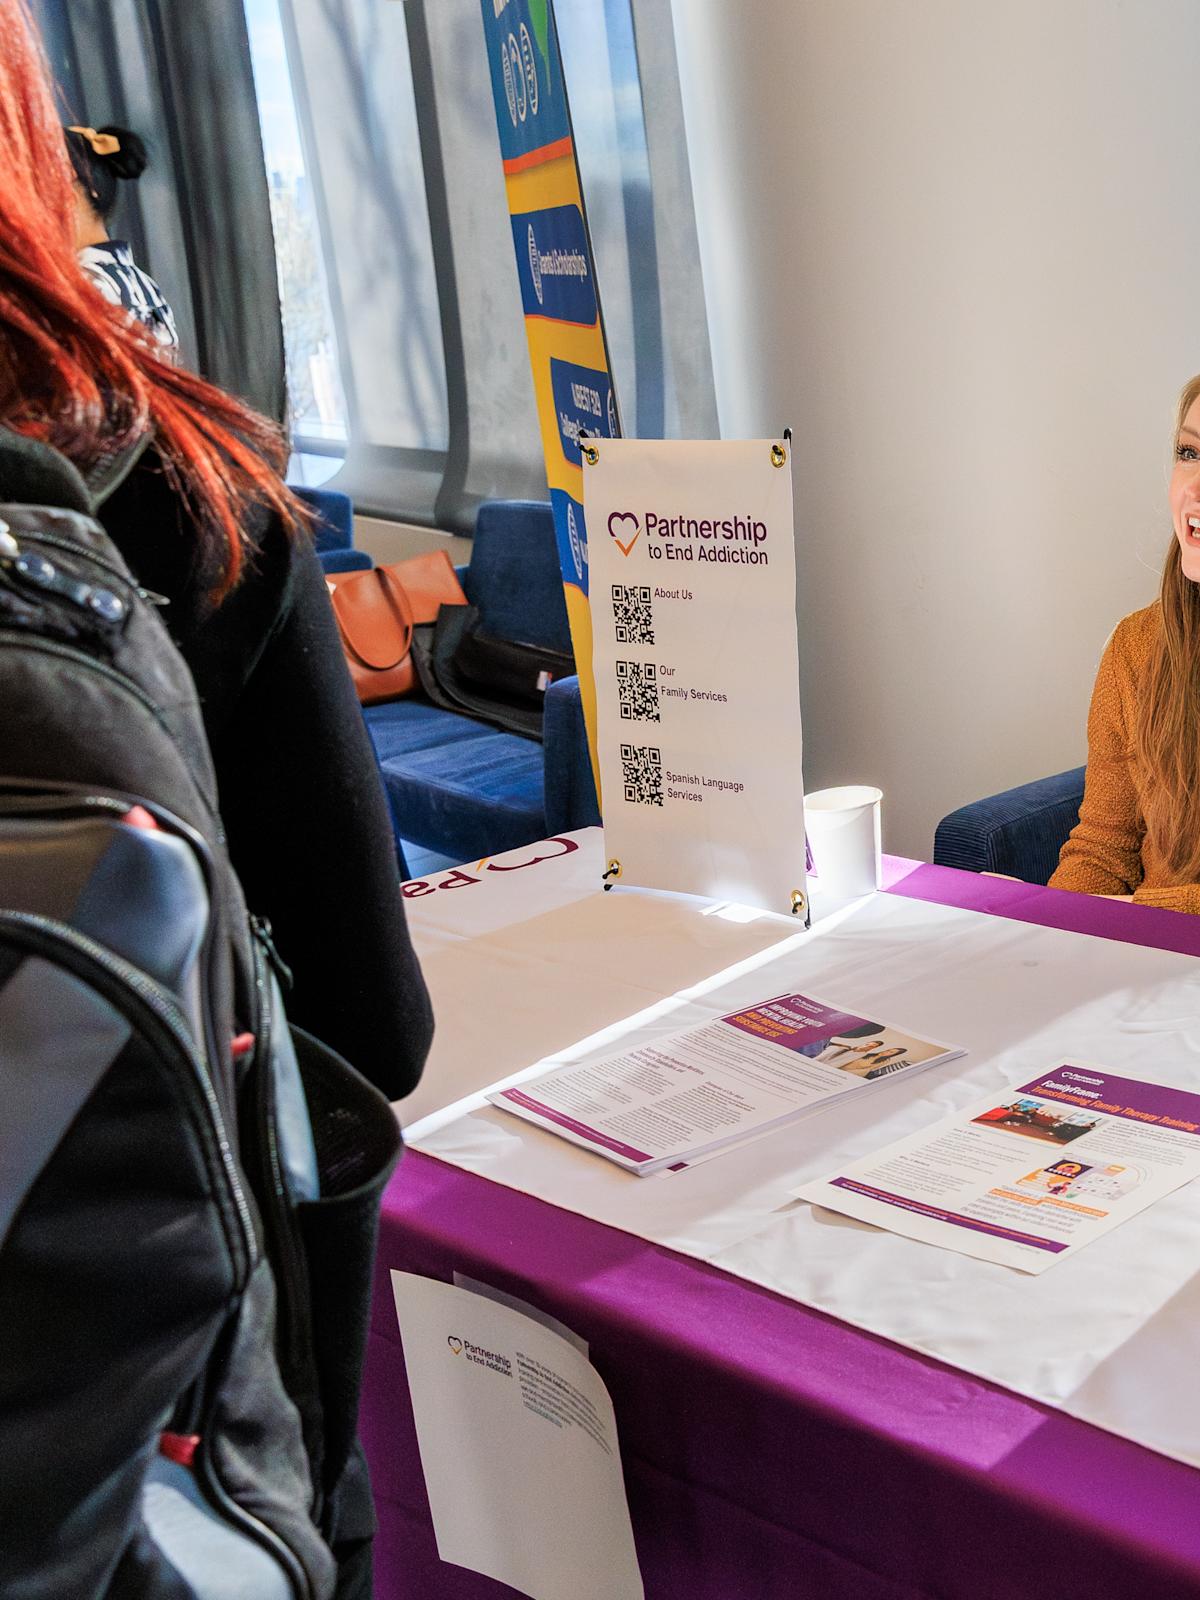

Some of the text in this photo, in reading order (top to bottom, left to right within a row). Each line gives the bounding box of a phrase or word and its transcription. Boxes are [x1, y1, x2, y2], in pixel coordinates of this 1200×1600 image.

[645, 512, 768, 547] Partnership
[648, 543, 769, 565] to End Addiction
[654, 587, 693, 600] About Us
[659, 665, 676, 677] Our
[661, 686, 728, 703] Family Services
[666, 771, 744, 793] Spanish Language
[667, 788, 703, 802] Services
[1031, 1086, 1200, 1132] Transforming Family Therapy Training
[464, 1339, 511, 1370] Partnership
[466, 1353, 473, 1361] to
[474, 1355, 485, 1366] End
